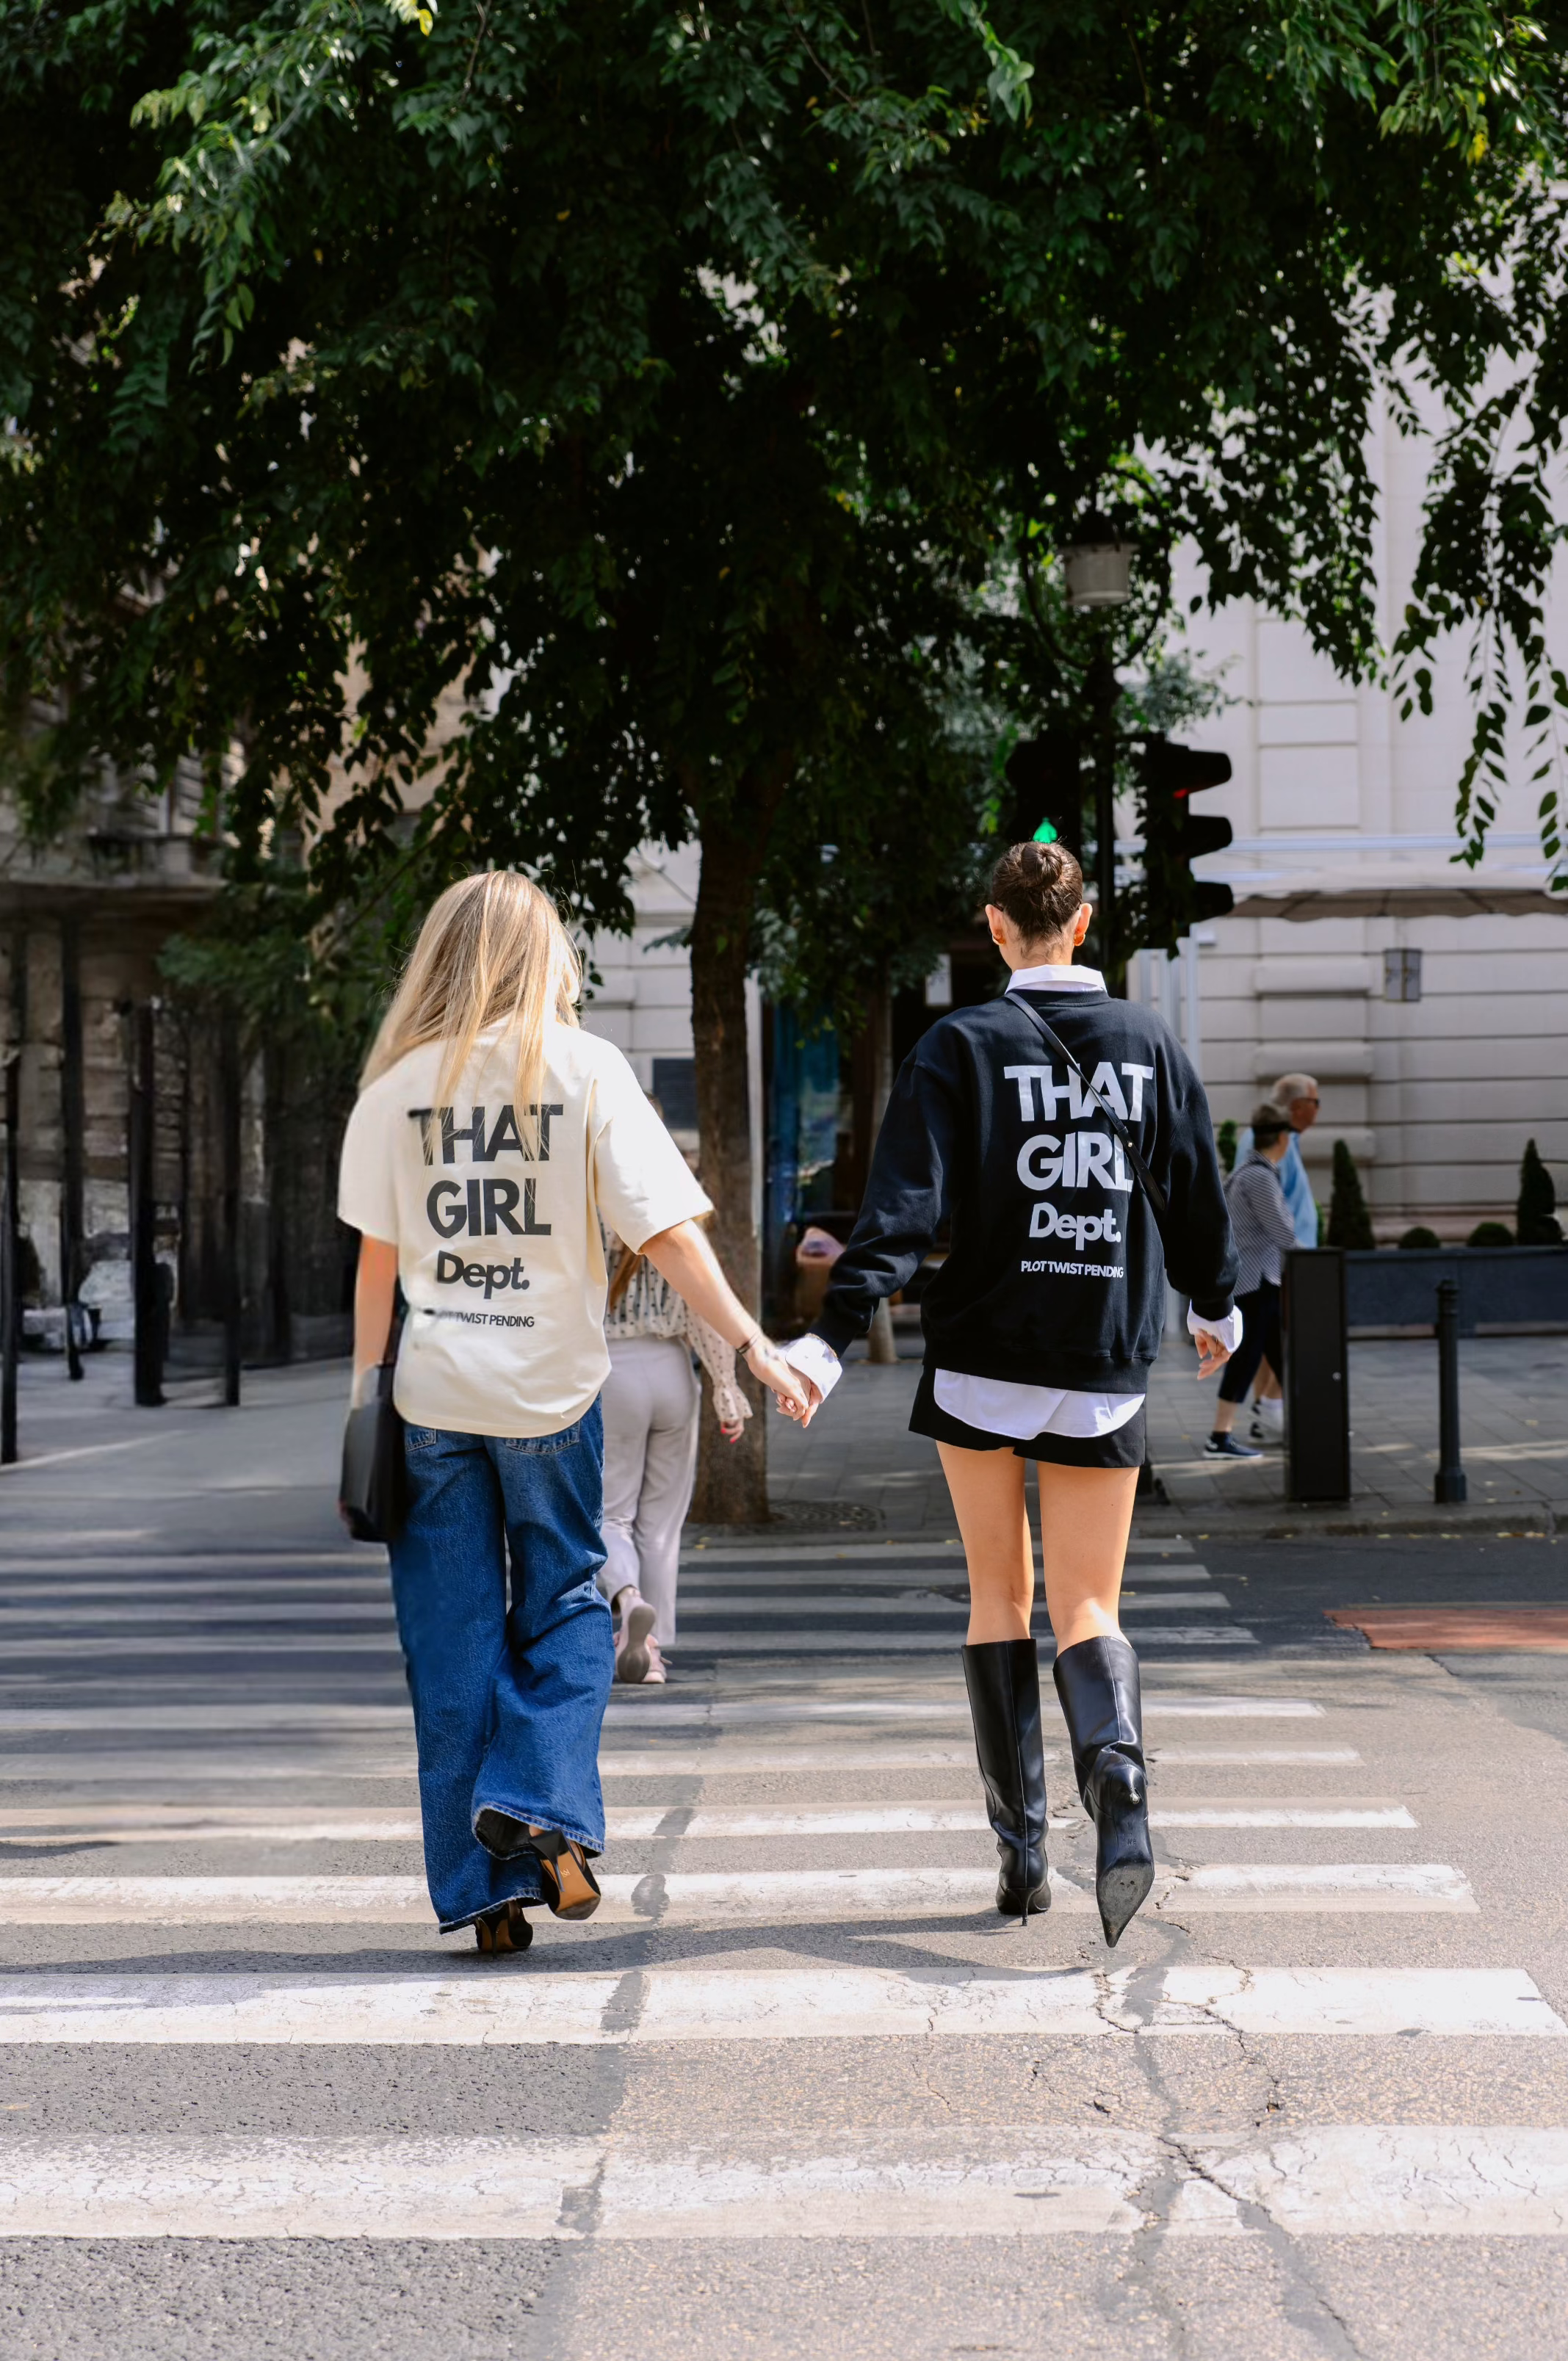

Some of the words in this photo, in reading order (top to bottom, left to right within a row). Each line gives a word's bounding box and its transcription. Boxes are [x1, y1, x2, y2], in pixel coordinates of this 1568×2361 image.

[1003, 1062, 1155, 1122] THAT
[407, 1104, 563, 1165] THAT
[1017, 1132, 1133, 1193] GIRL
[427, 1178, 552, 1238] GIRL
[1029, 1202, 1121, 1251] Dept.
[436, 1250, 530, 1299] Dept.
[1021, 1260, 1047, 1272] PLOT
[1047, 1262, 1084, 1275] TWIST
[1084, 1264, 1124, 1278] PENDING
[455, 1312, 488, 1325] TWIST
[489, 1315, 535, 1327] PENDING
